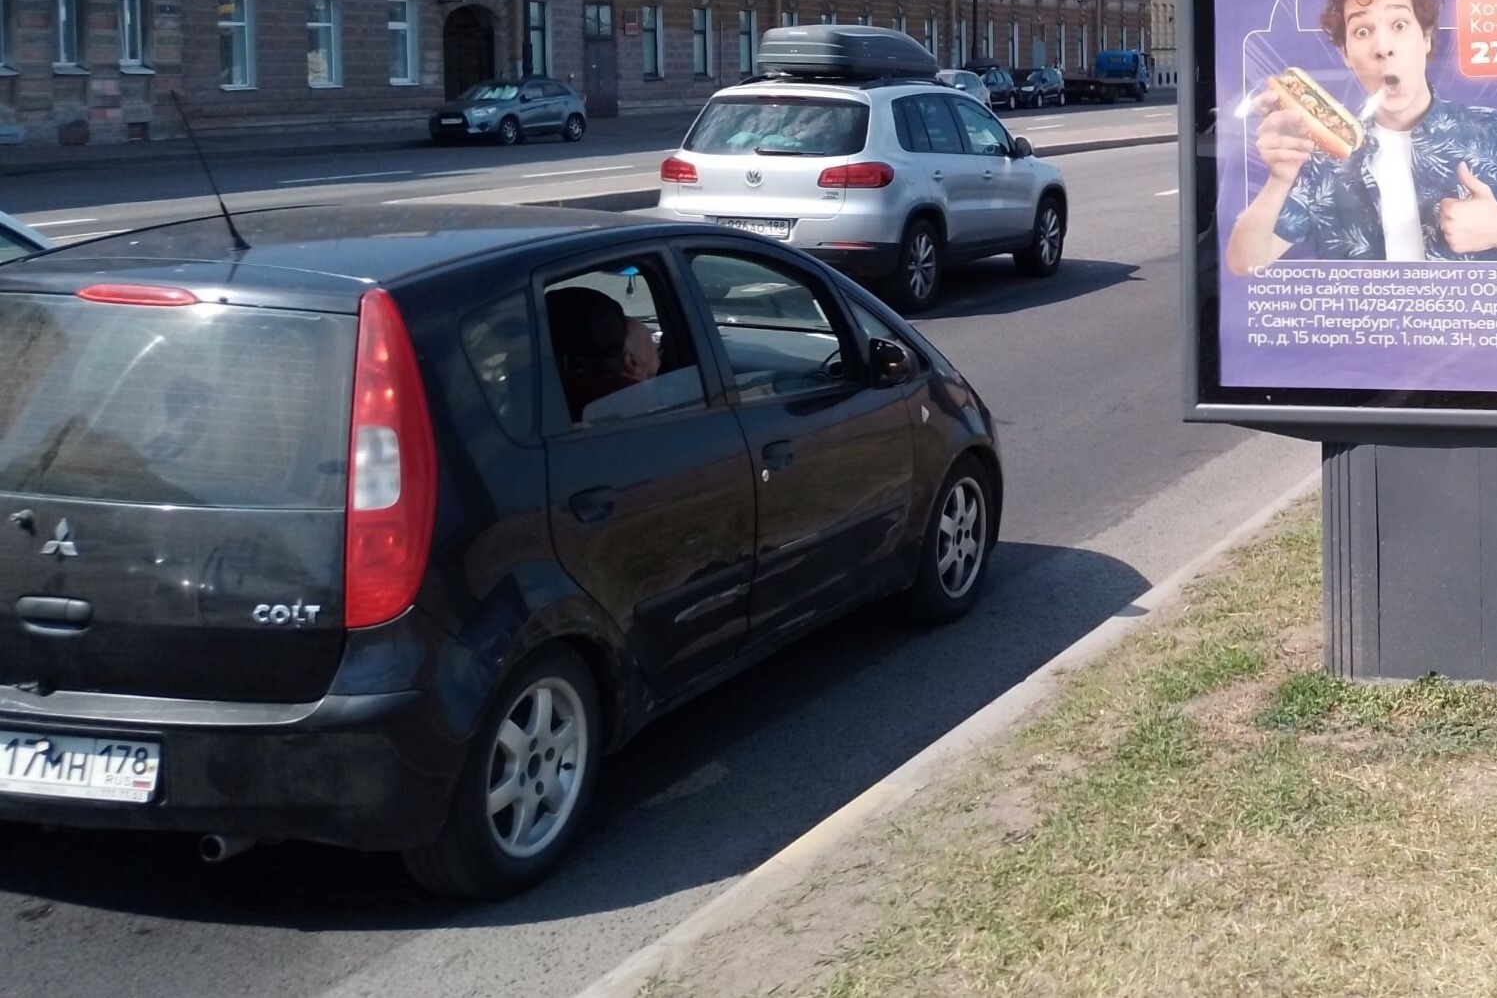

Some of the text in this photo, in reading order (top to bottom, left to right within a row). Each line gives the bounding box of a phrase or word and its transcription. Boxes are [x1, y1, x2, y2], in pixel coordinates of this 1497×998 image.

[1329, 267, 1400, 281] доставки
[1403, 268, 1464, 280] зависит
[1467, 269, 1485, 280] от
[1248, 283, 1291, 295] ности
[1295, 284, 1312, 295] на
[1316, 282, 1360, 296] сайте
[1363, 283, 1467, 299] dostaevsky.ru
[1248, 300, 1297, 314] кухня»
[1300, 299, 1344, 312] ОГРН
[1347, 299, 1468, 313] 1147847286630.
[1248, 317, 1259, 328] г.
[1262, 314, 1400, 331] Санкт-Петербург,
[1248, 333, 1274, 347] пр.,
[1276, 334, 1290, 346] д.
[1292, 331, 1309, 344] 15
[1312, 334, 1352, 347] корп.
[1355, 332, 1366, 345] 5
[1369, 335, 1398, 348] стр.
[1400, 332, 1411, 347] 1,
[1413, 335, 1448, 346] пом.
[1450, 333, 1476, 348] 3Н,
[252, 602, 321, 626] COLT
[98, 744, 149, 776] 178
